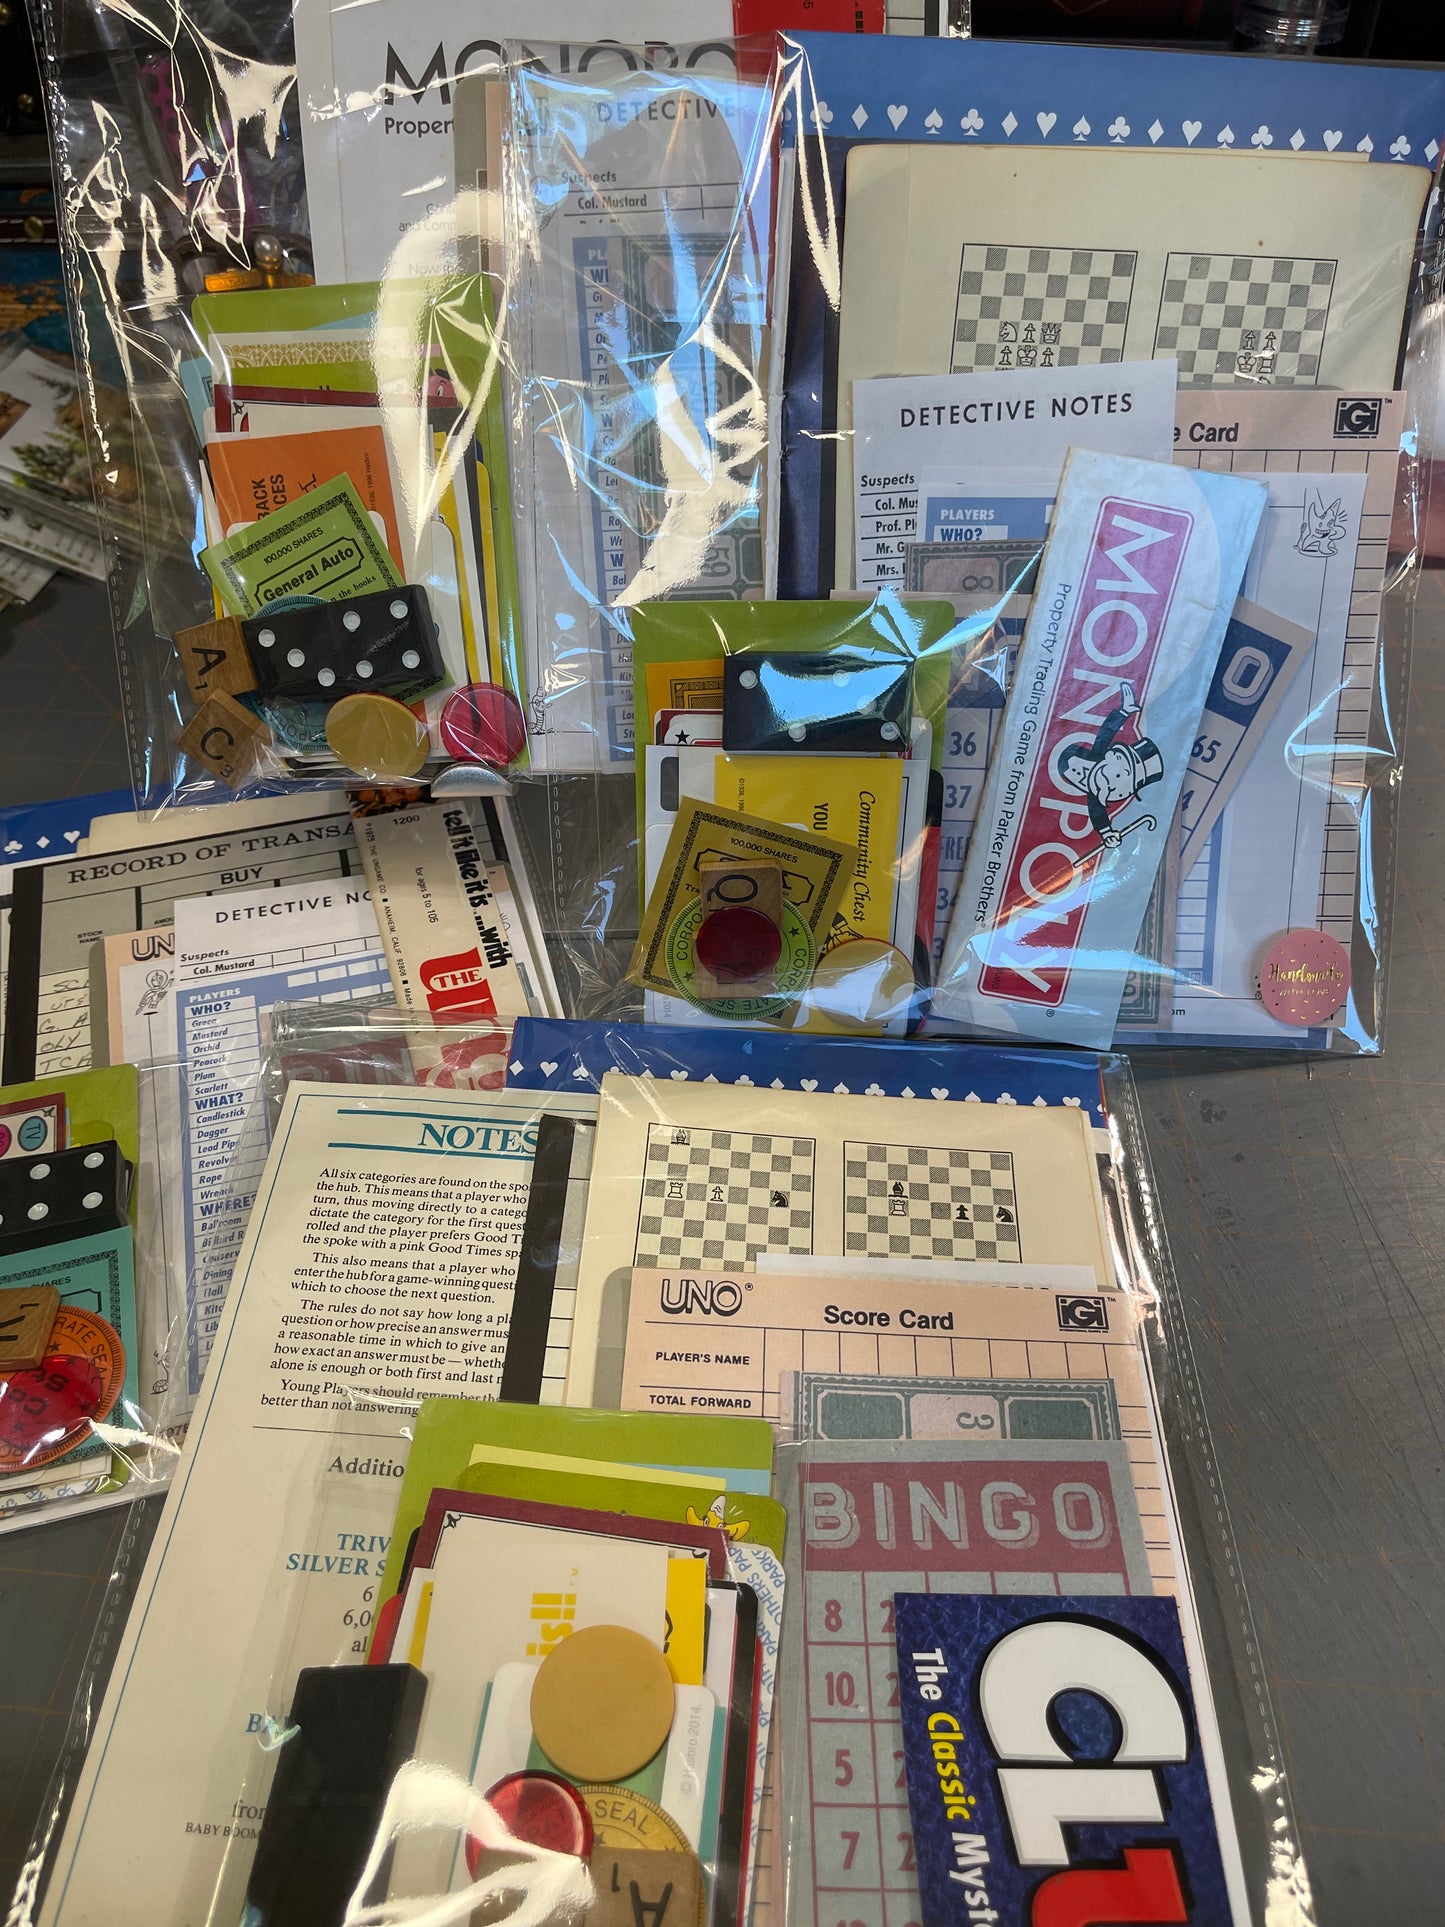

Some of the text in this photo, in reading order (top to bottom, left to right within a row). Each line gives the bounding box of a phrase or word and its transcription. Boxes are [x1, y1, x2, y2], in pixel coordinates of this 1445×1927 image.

[597, 98, 736, 123] DETECTIVE
[384, 117, 454, 138] Proper
[577, 194, 648, 210] Col. Mustard
[900, 392, 1133, 428] DETECTIVE NOTES
[1188, 422, 1240, 443] Card
[860, 473, 915, 489] Suspects
[874, 499, 896, 511] Col.
[940, 509, 996, 521] PLAYERS
[875, 521, 902, 533] Prof.
[940, 527, 984, 541] WHO?
[263, 527, 324, 565] 100,000 SHARES
[875, 543, 894, 555] Mr.
[263, 547, 355, 603] General Auto
[875, 564, 899, 576] Mrs.
[352, 575, 377, 592] books
[1041, 582, 1072, 655] Property
[190, 646, 227, 677] A
[1025, 657, 1054, 716] Trading
[200, 726, 234, 760] C
[949, 731, 977, 757] 36
[1013, 719, 1037, 766] Game
[944, 785, 973, 809] 37
[1002, 768, 1024, 809] from
[392, 814, 421, 827] 1200
[443, 809, 472, 837] tell
[812, 802, 829, 831] YOU
[450, 836, 474, 850] it
[989, 811, 1014, 861] Parker
[730, 837, 799, 864] 100,000 SHARES
[852, 790, 876, 923] Community Chest
[68, 851, 187, 884] RECORD
[195, 843, 232, 860] OF
[372, 858, 385, 883] UNGAME
[415, 866, 425, 877] for
[455, 849, 481, 880] like
[220, 866, 264, 885] BUY
[416, 877, 428, 893] ages
[464, 879, 488, 895] it
[215, 895, 333, 925] DETECTIVE
[424, 900, 432, 908] to
[469, 893, 493, 909] is
[427, 909, 439, 923] 105
[77, 930, 104, 939] STOCK
[180, 948, 230, 963] Suspects
[193, 958, 255, 976] Col. Mustard
[433, 969, 482, 989] THE
[189, 987, 241, 1003] PLAYERS
[191, 1001, 231, 1016] WHO?
[192, 1018, 217, 1028] Green
[192, 1027, 229, 1041] Mustard
[193, 1042, 221, 1054] Orchid
[193, 1054, 227, 1068] Peacock
[194, 1071, 216, 1082] Plum
[195, 1083, 228, 1095] Scarlett
[195, 1092, 244, 1111] WHAT?
[196, 1107, 246, 1124] Candlestick
[197, 1126, 229, 1139] Dagger
[417, 1122, 537, 1154] NOTES
[198, 1142, 219, 1154] Lead
[199, 1174, 223, 1185] Rope
[319, 1167, 339, 1178] All
[340, 1169, 357, 1180] six
[358, 1172, 416, 1184] categories
[418, 1177, 437, 1185] are
[438, 1176, 472, 1188] found
[473, 1181, 487, 1189] on
[489, 1180, 507, 1190] the
[316, 1181, 527, 1204] the hub. This means that a player who
[291, 1280, 495, 1303] which to choose the next question.
[823, 1304, 955, 1332] Score Card
[654, 1351, 751, 1366] PLAYER'S NAME
[270, 1358, 494, 1384] alone is enough or both first and last
[648, 1394, 752, 1409] TOTAL FORWARD
[804, 1480, 1113, 1550] BINGO
[285, 1553, 369, 1576] SILVER
[824, 1599, 843, 1632] 8
[911, 1646, 948, 1701] The
[824, 1671, 855, 1707] 10
[834, 1750, 854, 1787] 5
[926, 1711, 978, 1820] Classic
[594, 1799, 651, 1836] SEAL
[185, 1821, 221, 1837] BABY
[840, 1831, 860, 1870] 7
